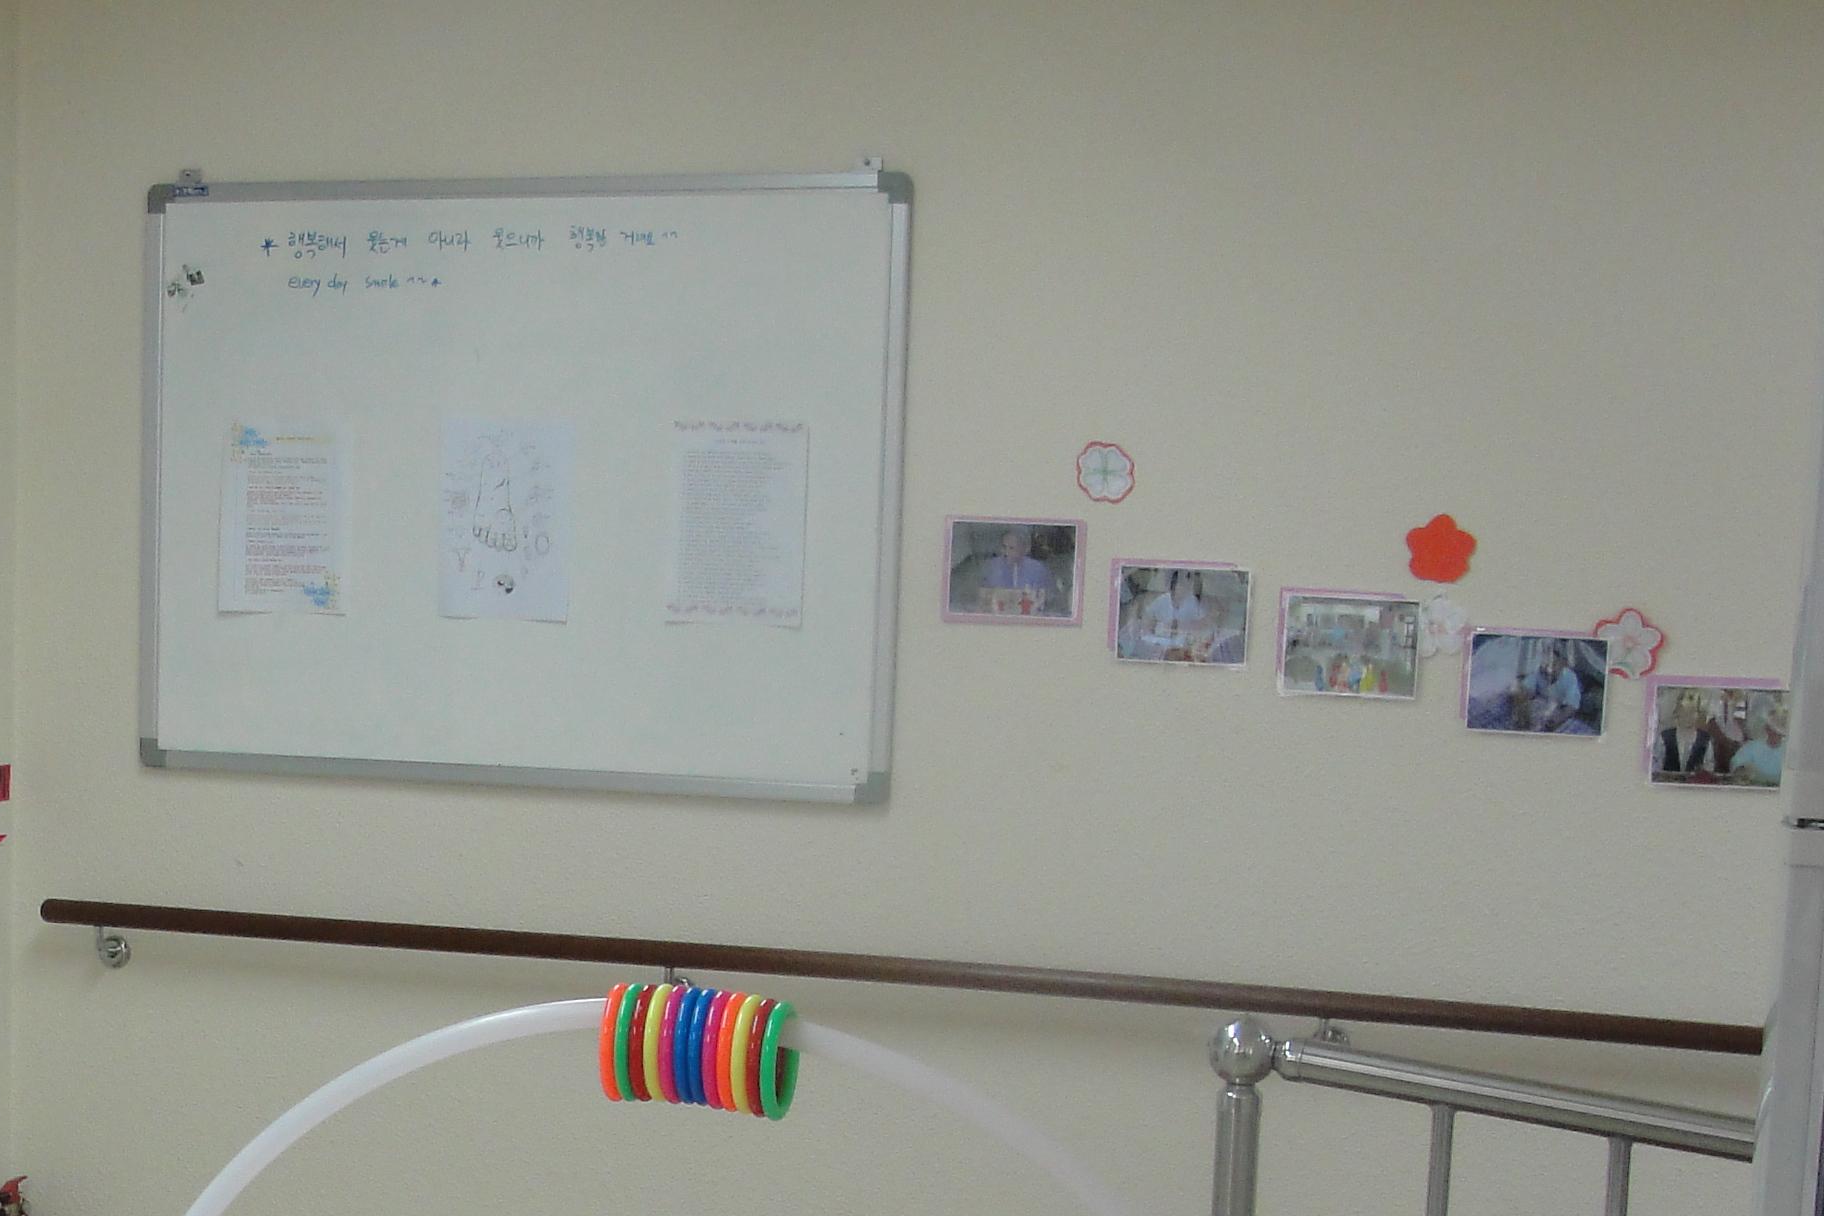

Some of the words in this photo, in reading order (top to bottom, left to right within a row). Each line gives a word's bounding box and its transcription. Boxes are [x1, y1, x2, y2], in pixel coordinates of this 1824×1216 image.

[288, 231, 347, 259] 행복해서
[428, 230, 471, 252] 아니라
[288, 276, 321, 297] every
[327, 273, 347, 296] day
